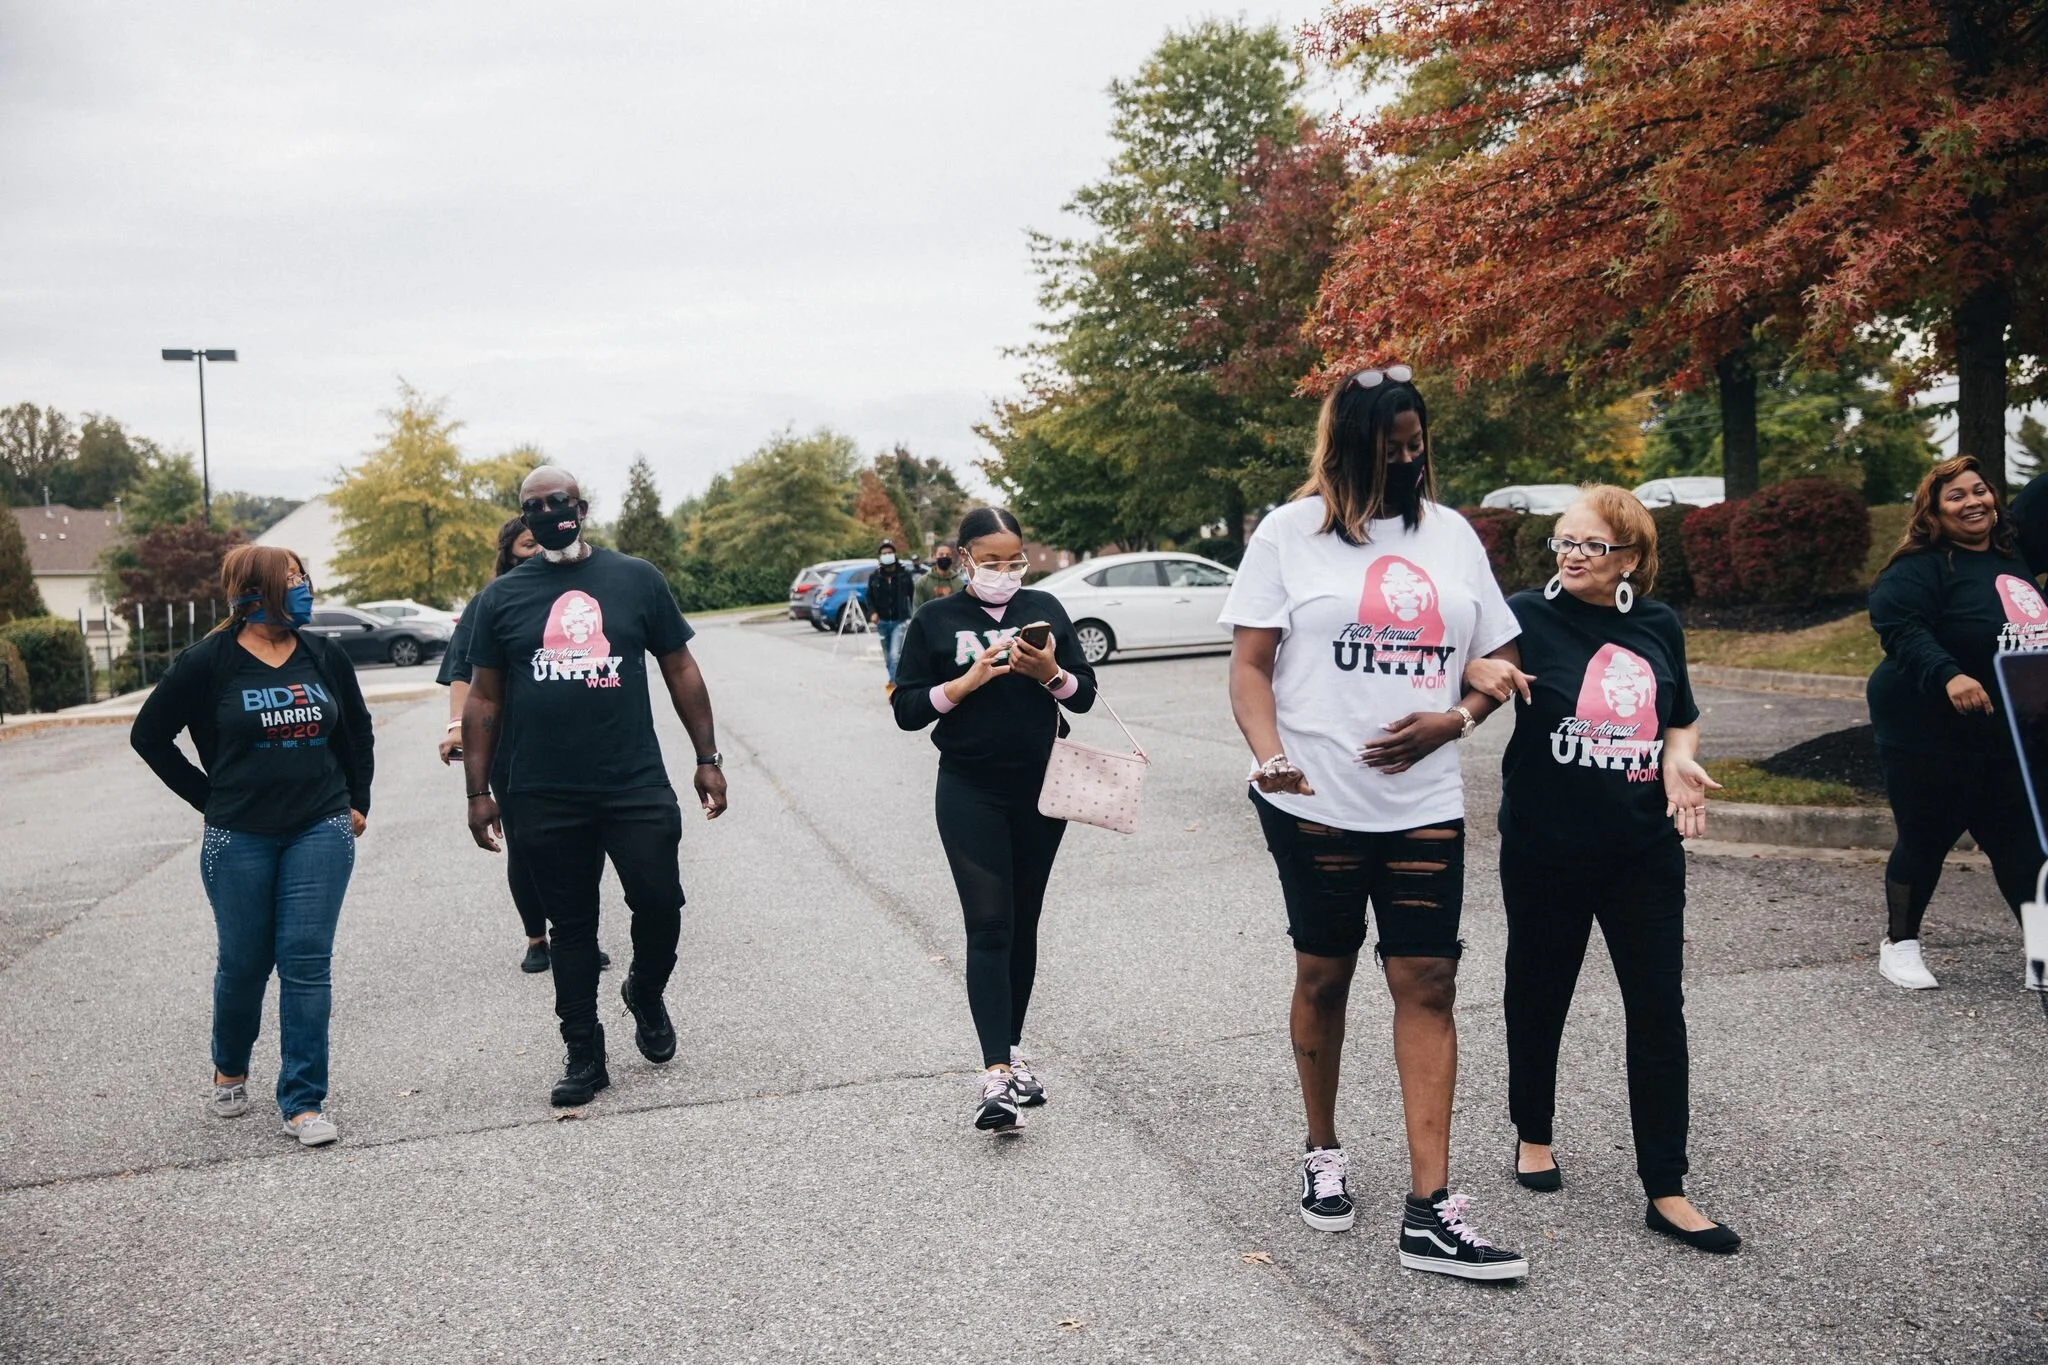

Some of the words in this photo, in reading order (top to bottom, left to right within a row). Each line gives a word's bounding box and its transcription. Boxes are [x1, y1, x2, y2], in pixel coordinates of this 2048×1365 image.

[1339, 622, 1374, 641] Fifth
[1373, 624, 1424, 642] Annual
[1332, 640, 1456, 676] UNITY
[530, 656, 623, 682] UNITY
[1410, 670, 1447, 689] walk
[585, 676, 622, 689] walk
[242, 683, 329, 711] BIDEN
[260, 706, 323, 727] HARRIS
[1556, 716, 1592, 736] Fifth
[1591, 719, 1641, 737] Annual
[266, 722, 320, 740] 2020
[1549, 732, 1664, 770] UNITY
[1626, 765, 1660, 783] walk
